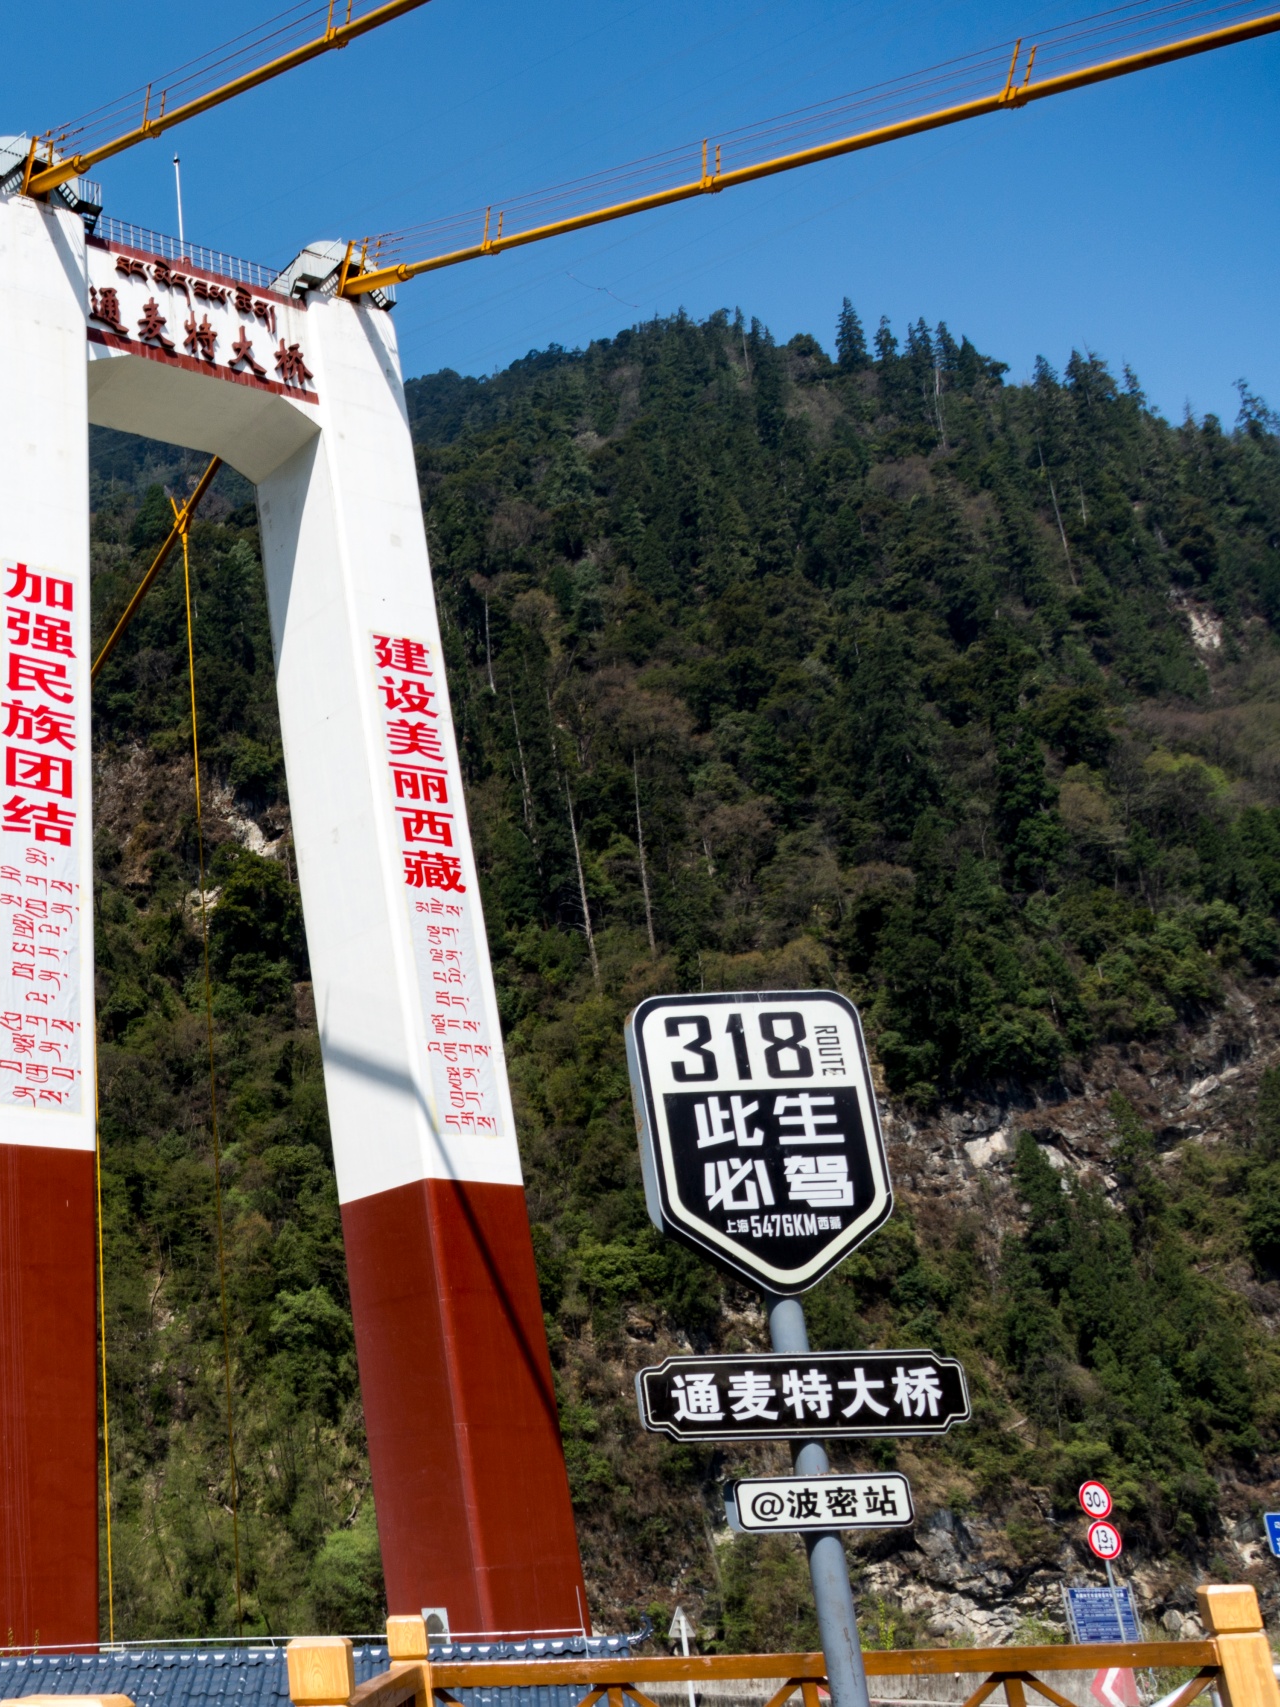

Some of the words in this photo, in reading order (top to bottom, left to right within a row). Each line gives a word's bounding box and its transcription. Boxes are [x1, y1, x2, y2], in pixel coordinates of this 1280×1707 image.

[1, 562, 77, 847] 加强民族团结
[372, 635, 467, 894] 建设美丽西藏
[664, 1012, 814, 1082] 318
[814, 1025, 846, 1077] ROUTE
[694, 1093, 845, 1149] 此生
[704, 1155, 854, 1211] 必驾
[671, 1366, 943, 1422] 通麦特大桥
[751, 1485, 898, 1522] @波密站
[1085, 1491, 1106, 1508] 30t
